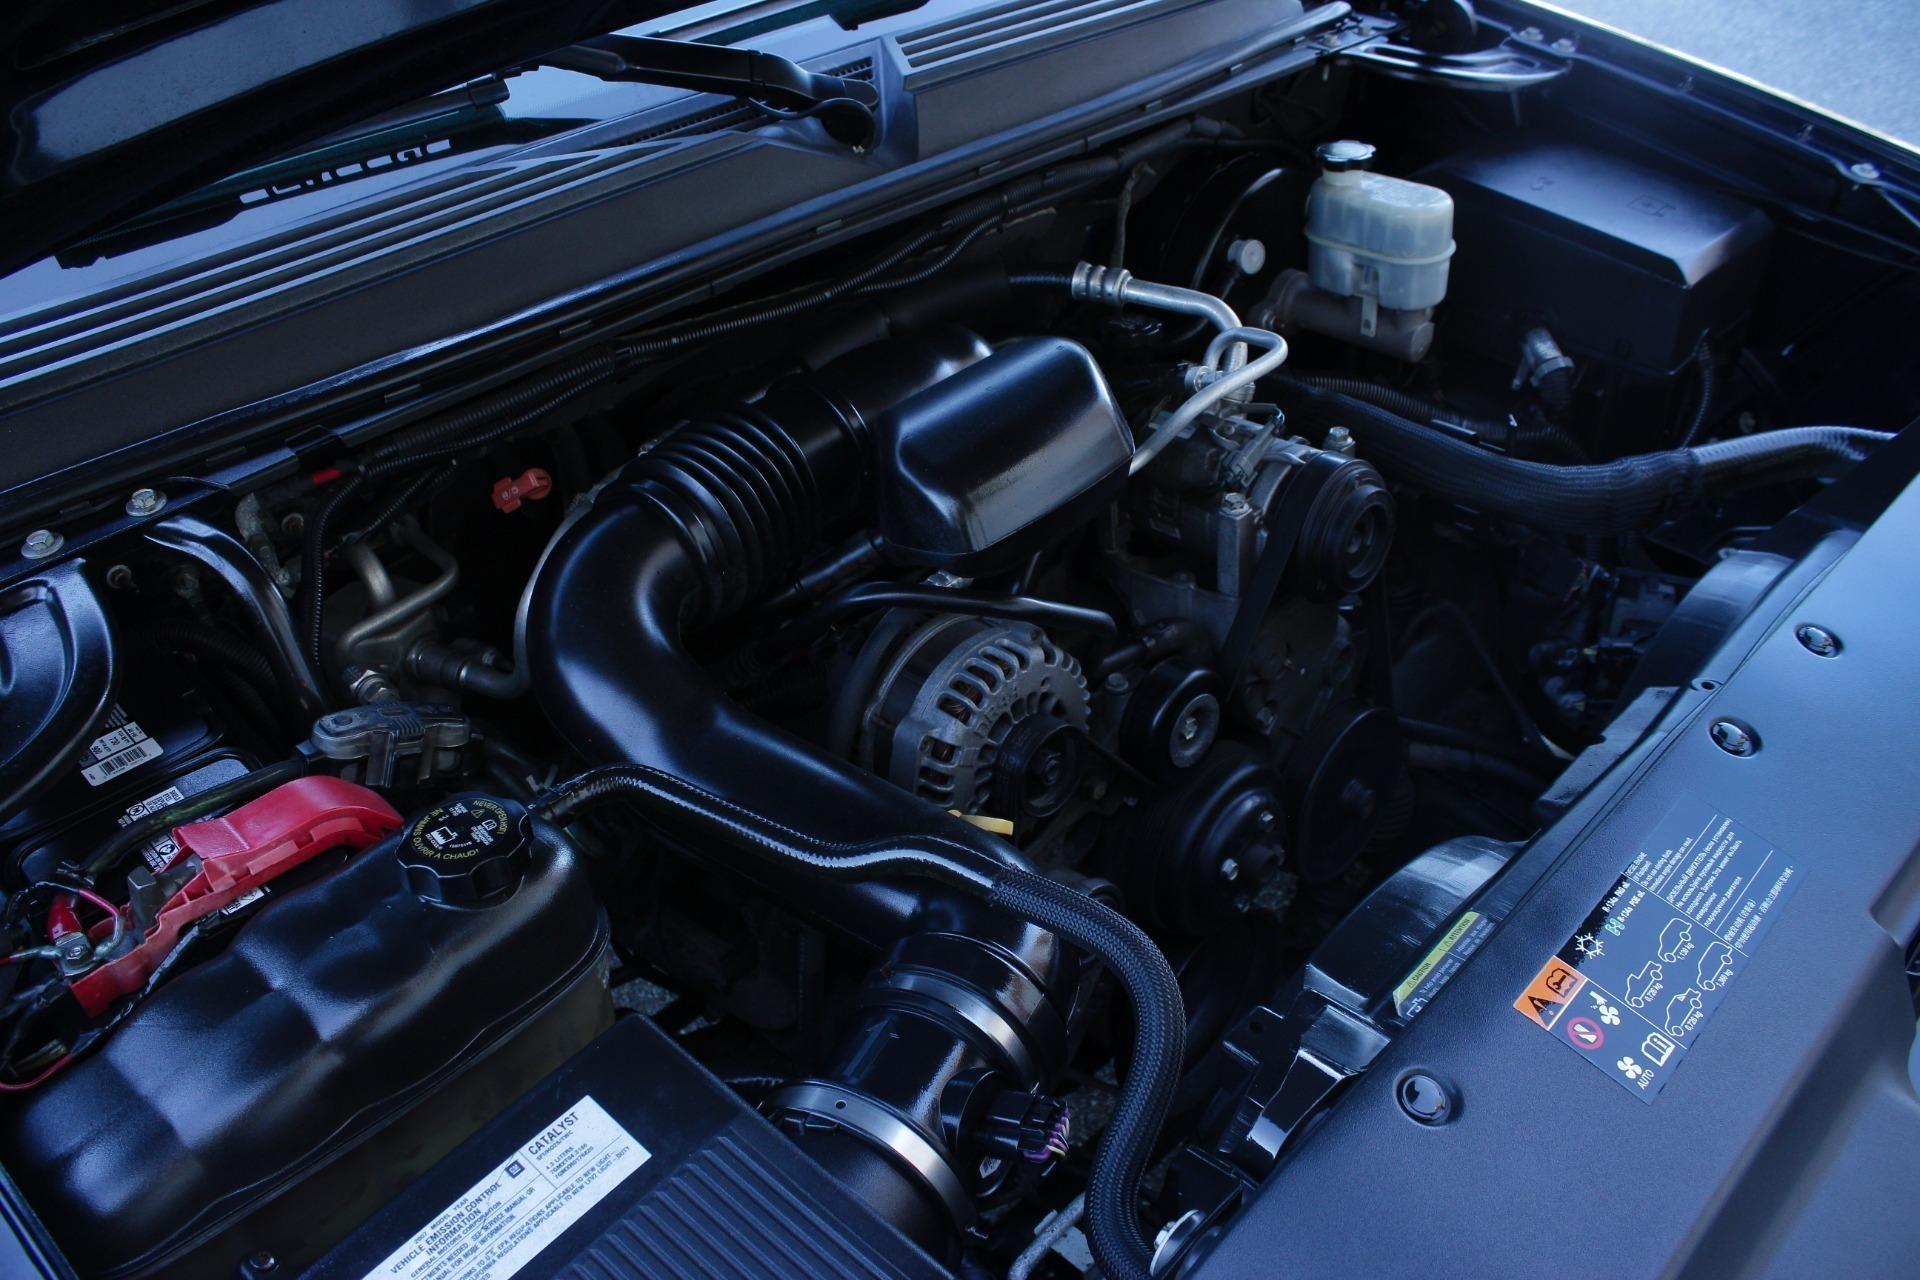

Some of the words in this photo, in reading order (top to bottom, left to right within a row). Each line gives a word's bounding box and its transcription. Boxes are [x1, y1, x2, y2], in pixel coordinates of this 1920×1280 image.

[473, 800, 497, 809] NEVER
[412, 837, 434, 856] OUVRIR
[442, 848, 479, 859] CHAUD!
[1637, 1069, 1654, 1090] AUTO
[528, 1111, 578, 1155] CATALYST
[390, 1244, 425, 1274] VEHICLE
[425, 1211, 465, 1245] EMISSION
[464, 1181, 501, 1212] CONTROL
[425, 1208, 482, 1255] INFORMATION
[430, 1213, 450, 1230] MODEL
[452, 1197, 469, 1211] YEAR
[470, 1229, 483, 1242] SEE
[480, 1212, 504, 1232] SERVICE
[503, 1194, 527, 1213] MANUAL
[525, 1186, 535, 1195] OR
[475, 1259, 486, 1268] TO
[496, 1239, 510, 1251] EPA
[508, 1208, 546, 1241] REGULATIONS
[544, 1183, 577, 1210] APPLICABLE
[574, 1176, 584, 1184] TO
[582, 1166, 596, 1178] NEW
[493, 1226, 534, 1259] REGULATIONS
[532, 1201, 564, 1229] APPLICABLE
[563, 1194, 573, 1202] TO
[571, 1183, 585, 1196] NEW
[410, 1255, 437, 1278] GENERAL
[436, 1233, 462, 1256] MOTORS
[461, 1200, 502, 1235] CORPORATION
[450, 1257, 464, 1269] FOR
[462, 1244, 479, 1259] MORE
